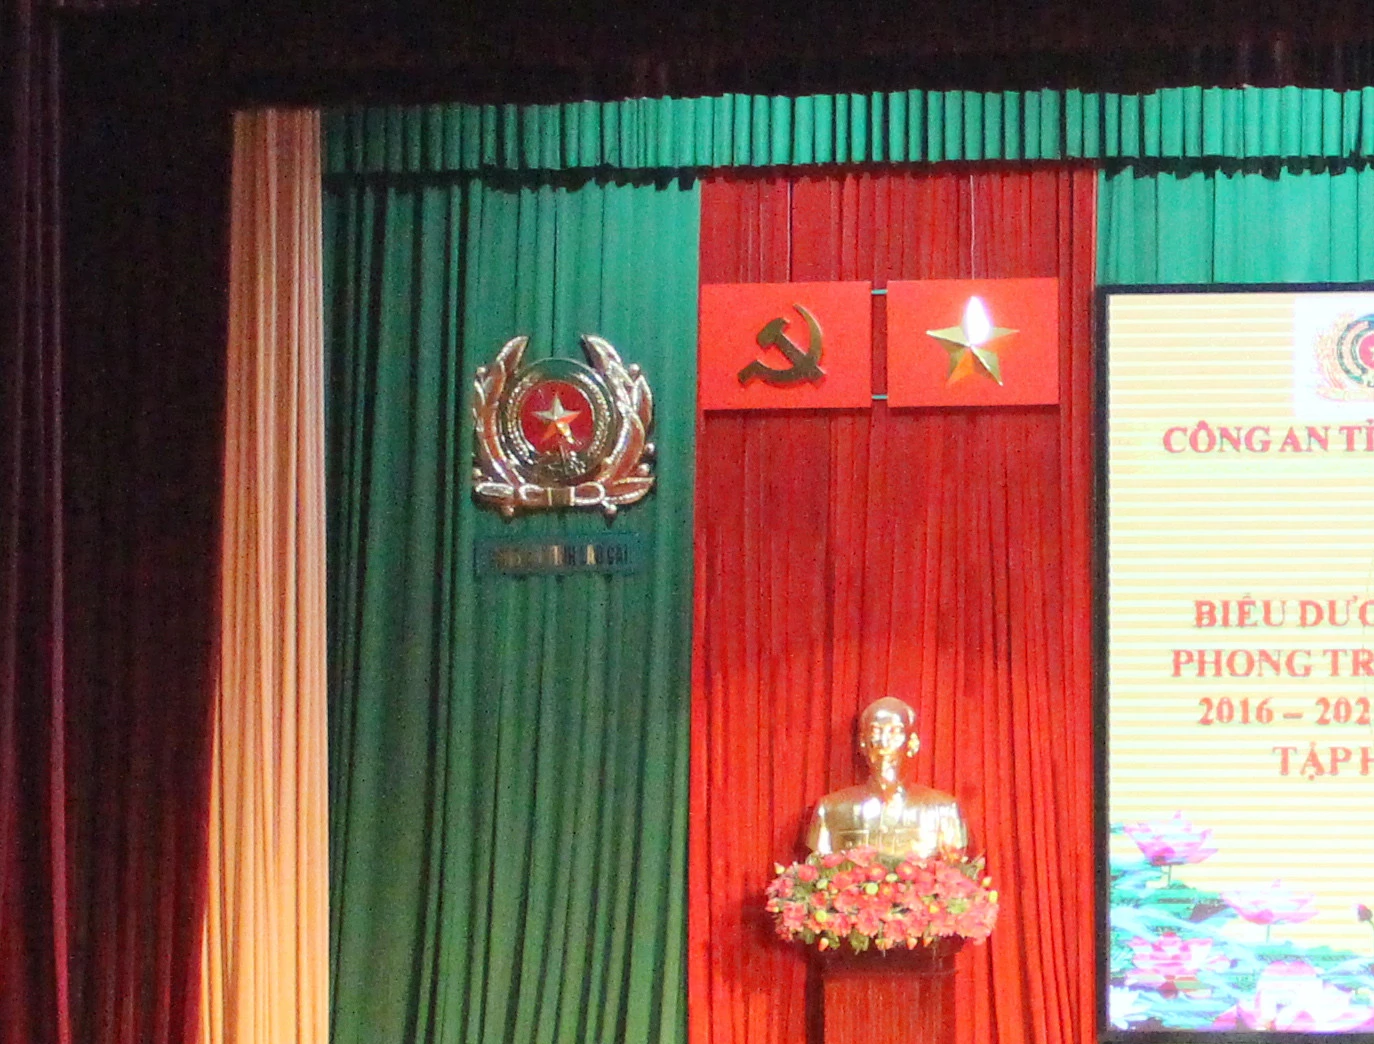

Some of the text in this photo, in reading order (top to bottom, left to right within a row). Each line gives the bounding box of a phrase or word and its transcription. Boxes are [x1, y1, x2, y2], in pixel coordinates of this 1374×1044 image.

[1162, 420, 1271, 453] CÔNG
[1280, 425, 1330, 452] AN
[1171, 649, 1313, 677] PHONG
[1197, 697, 1274, 725] 2016
[1273, 741, 1353, 781] TẬP
